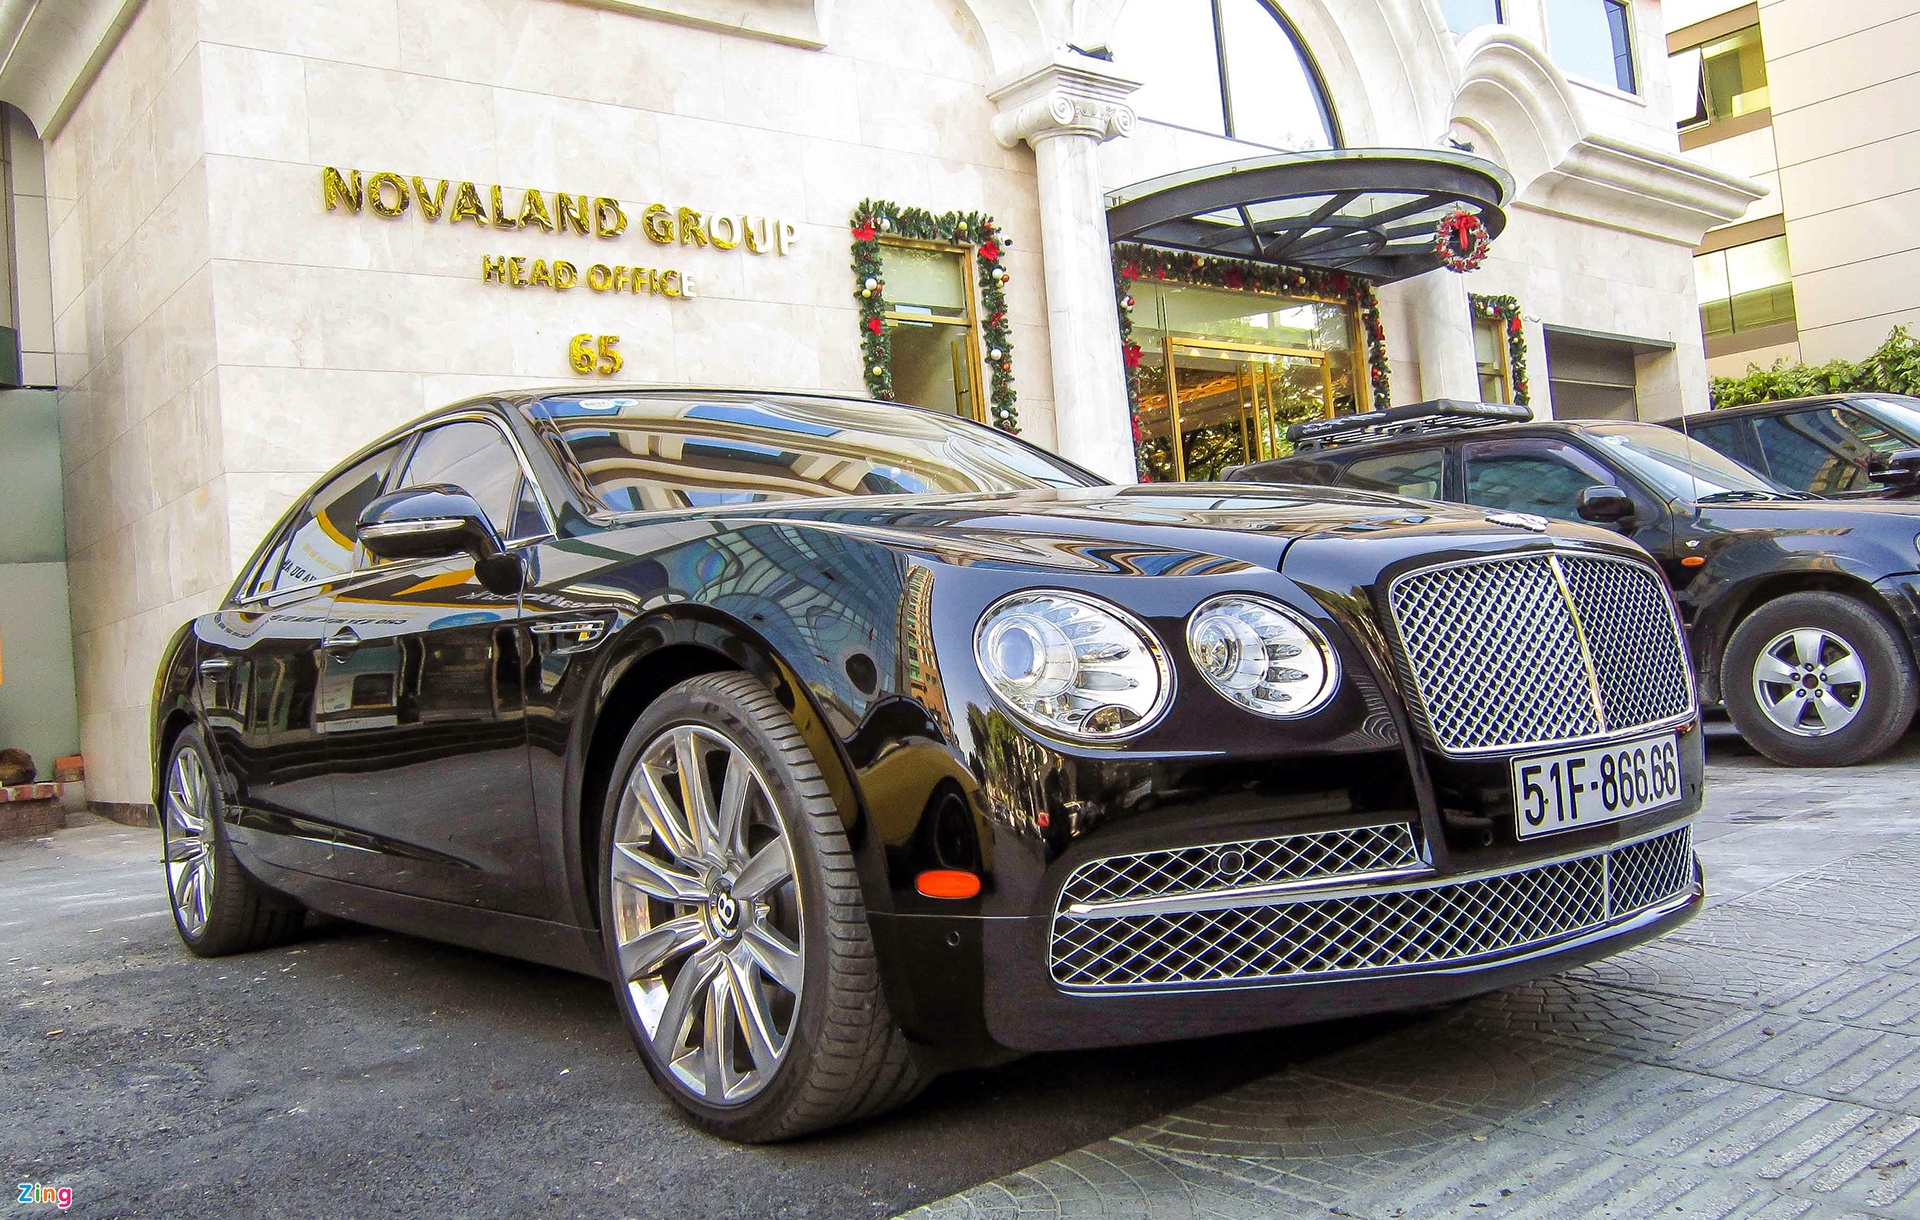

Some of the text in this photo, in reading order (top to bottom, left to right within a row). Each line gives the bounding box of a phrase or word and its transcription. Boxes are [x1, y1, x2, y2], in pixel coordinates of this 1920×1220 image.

[322, 165, 800, 256] NOVALAND GROUP
[482, 254, 697, 300] HEAD OFFICE
[569, 333, 625, 375] 65
[1521, 741, 1677, 827] 51F-866.66
